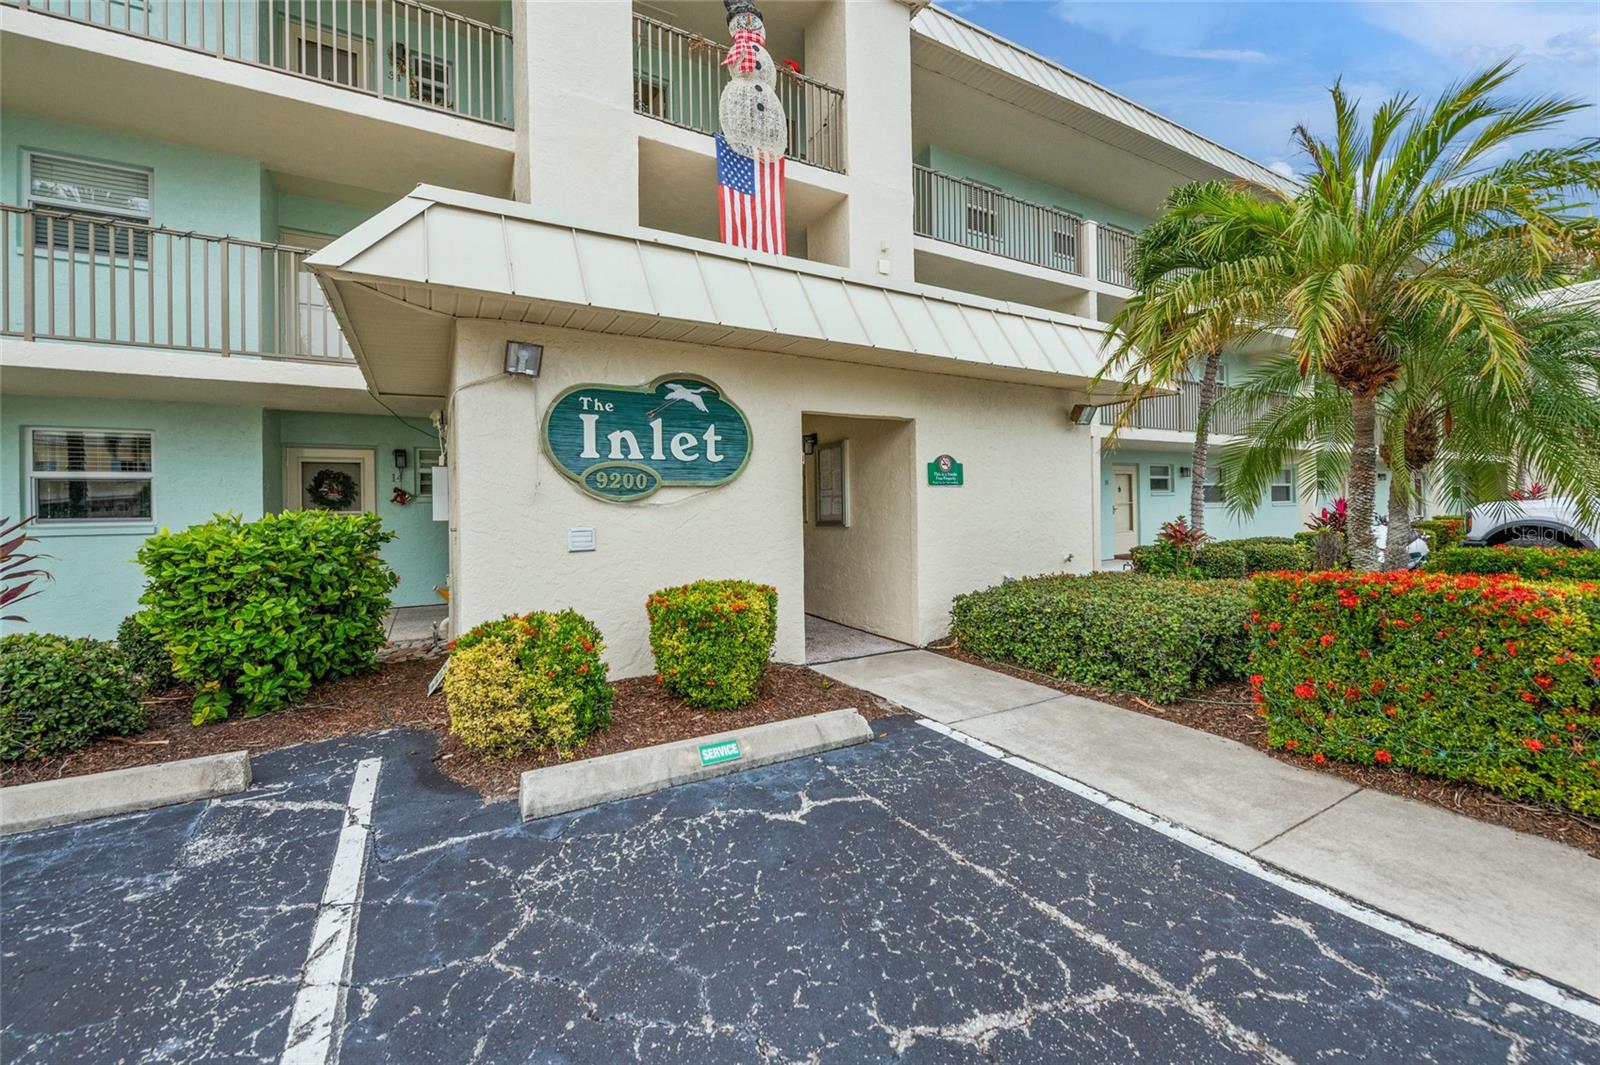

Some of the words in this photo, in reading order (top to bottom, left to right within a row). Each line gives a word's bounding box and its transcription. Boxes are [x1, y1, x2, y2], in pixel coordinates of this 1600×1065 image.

[579, 396, 614, 412] The
[579, 414, 724, 462] Inlet
[596, 471, 648, 489] 9200
[703, 744, 739, 760] SERVICE
